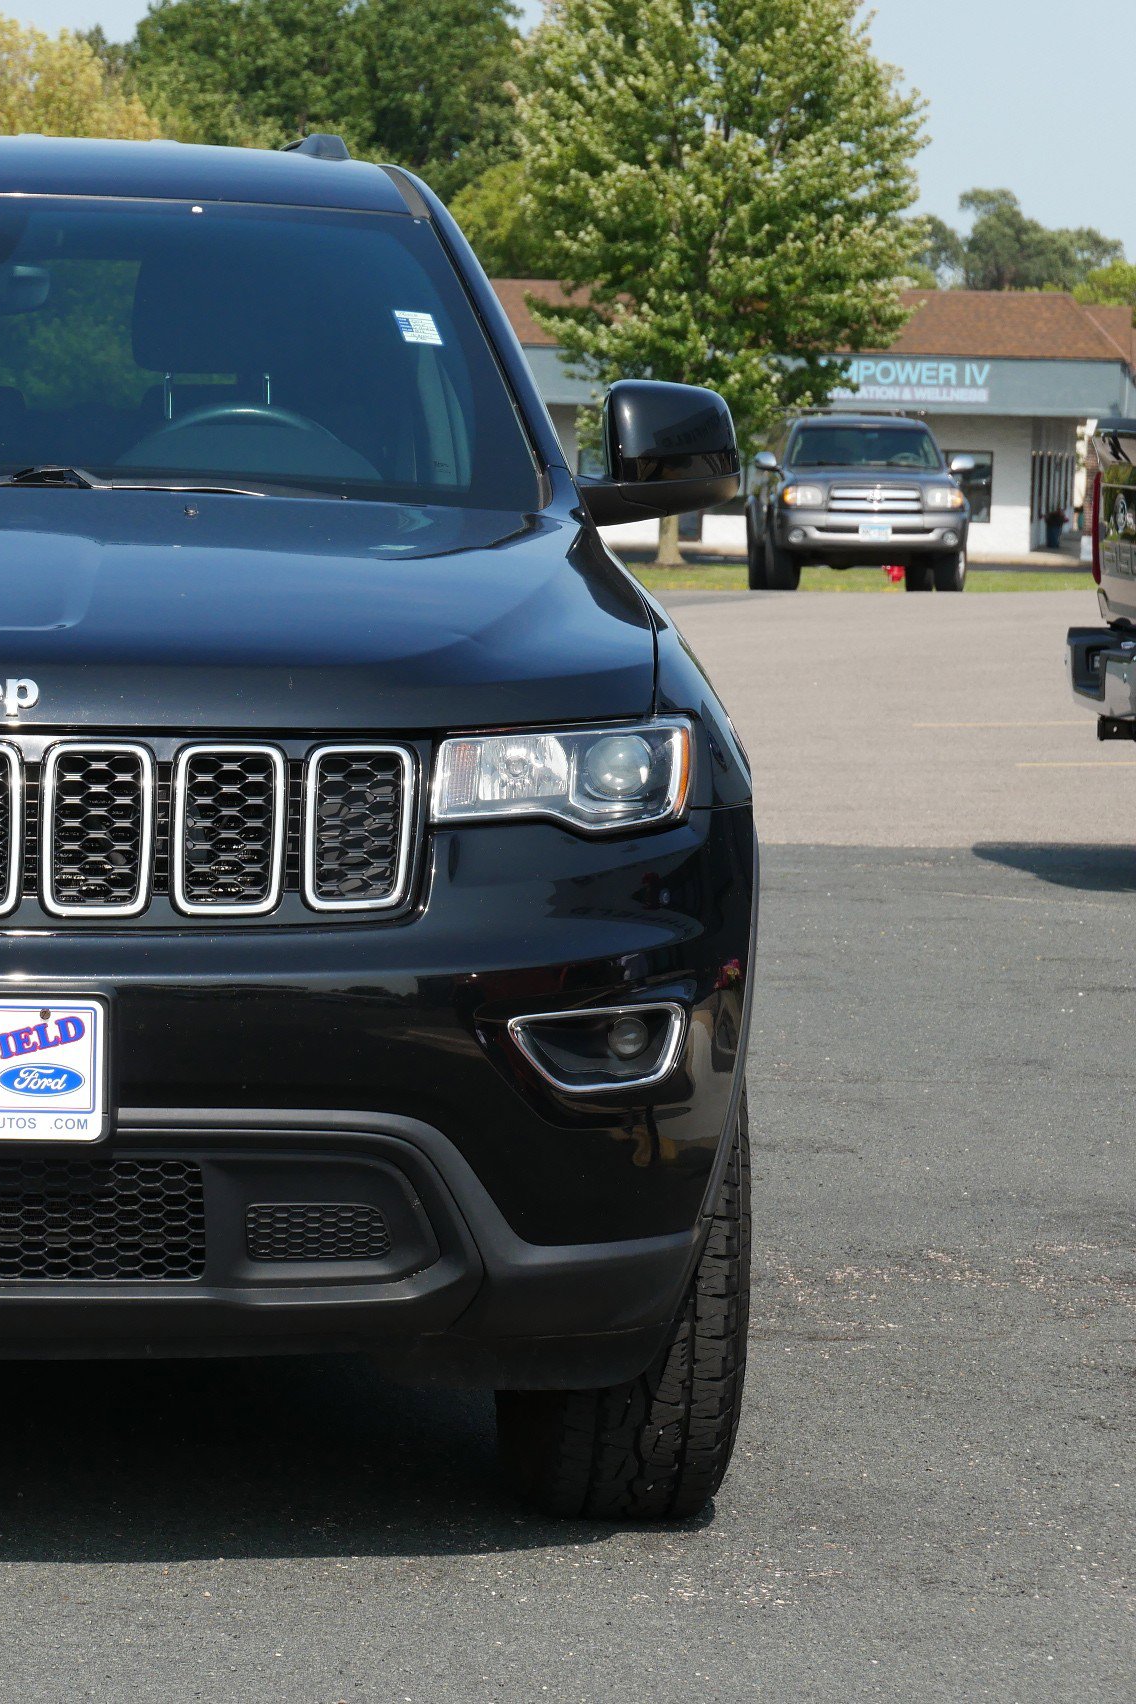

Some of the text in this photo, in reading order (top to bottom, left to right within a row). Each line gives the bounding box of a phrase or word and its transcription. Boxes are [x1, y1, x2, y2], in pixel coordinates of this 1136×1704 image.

[820, 360, 991, 386] MPOWER IV
[13, 1067, 67, 1091] Ford
[49, 1118, 89, 1130] .COM
